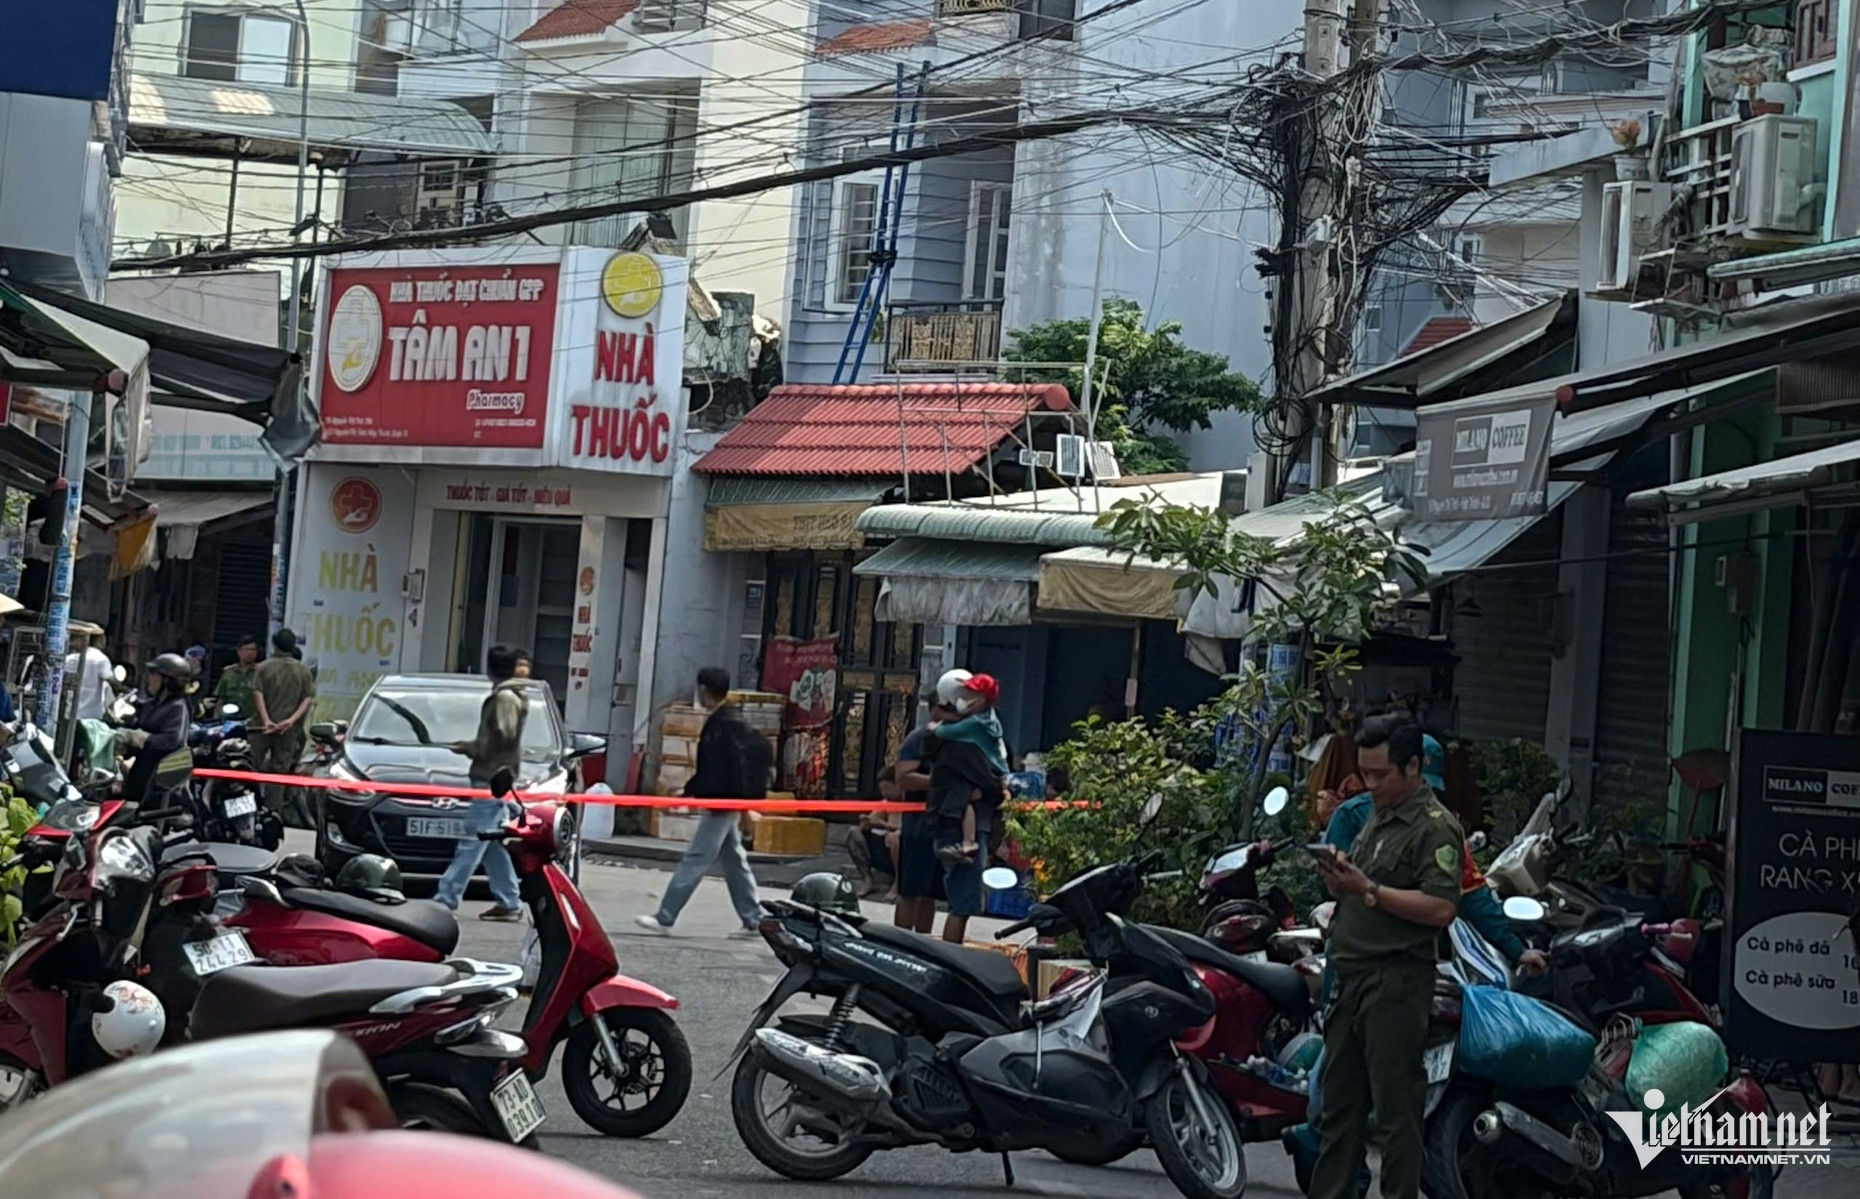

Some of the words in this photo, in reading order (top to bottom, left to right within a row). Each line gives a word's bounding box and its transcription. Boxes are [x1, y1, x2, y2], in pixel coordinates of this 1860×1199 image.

[389, 275, 413, 302] NHÀ
[416, 271, 454, 302] THUỐC
[387, 309, 458, 381] TÂM
[594, 321, 654, 386] NHÀ
[466, 389, 525, 415] Pharmacy
[571, 393, 670, 463] THUỐC
[1454, 428, 1488, 453] MILANO
[1491, 424, 1527, 449] COFFEE
[318, 543, 378, 593] NHÀ
[301, 602, 397, 658] THUỐC
[1768, 778, 1824, 793] MILANO
[1779, 829, 1818, 858] CÀ
[1825, 836, 1860, 861] PH
[1760, 864, 1833, 892] RANG
[1841, 871, 1860, 893] X
[1747, 936, 1770, 951] Cà
[1775, 938, 1804, 955] phê
[1809, 940, 1831, 955] đá
[1745, 969, 1769, 985] Cà
[1773, 972, 1803, 989] phê
[1807, 973, 1836, 989] sữa
[1842, 989, 1858, 1005] 18
